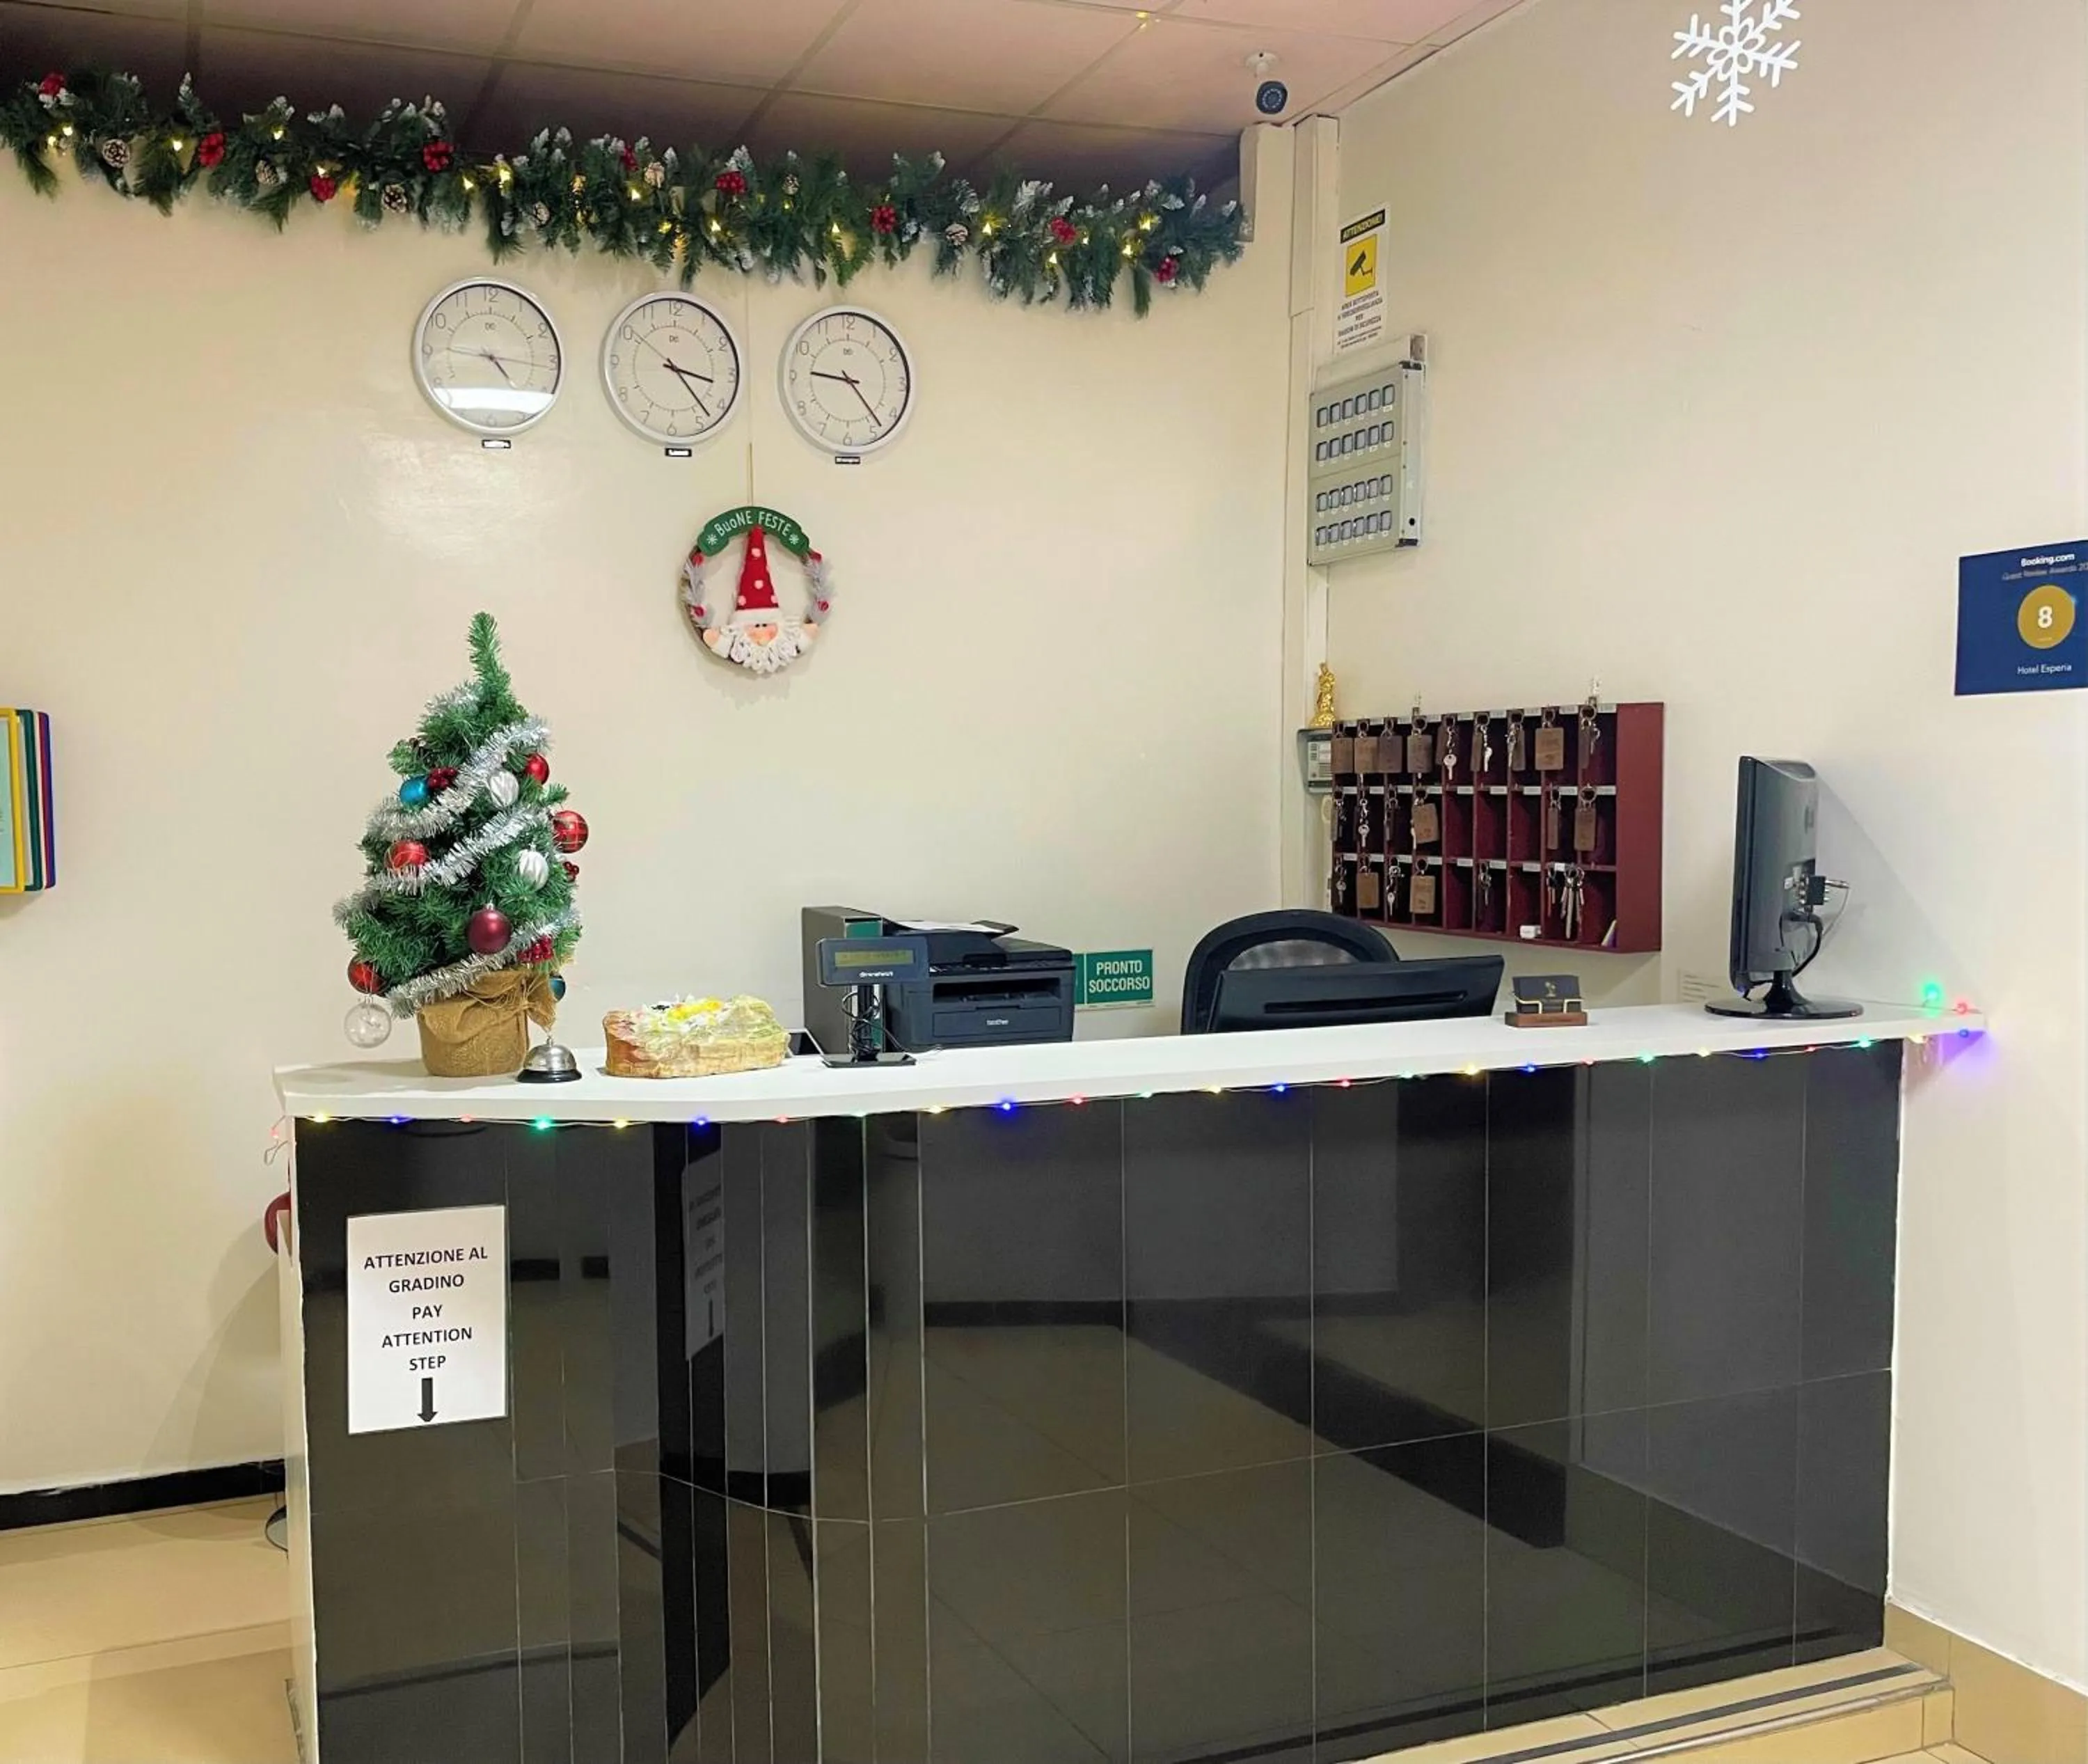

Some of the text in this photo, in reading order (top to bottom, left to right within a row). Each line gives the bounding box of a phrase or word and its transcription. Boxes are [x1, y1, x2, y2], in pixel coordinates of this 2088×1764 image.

[456, 292, 468, 307] 11
[484, 287, 498, 302] 12
[642, 305, 654, 320] 11
[668, 301, 683, 317] 12
[429, 313, 446, 329] 10
[818, 320, 828, 335] 11
[841, 315, 855, 330] 12
[538, 322, 548, 338] 2
[619, 325, 633, 340] 10
[718, 336, 727, 352] 2
[796, 341, 809, 356] 10
[548, 355, 557, 370] 3
[610, 354, 619, 369] 9
[889, 348, 898, 363] 2
[728, 367, 736, 384] 3
[789, 370, 797, 385] 9
[899, 377, 906, 392] 3
[619, 386, 628, 402] 8
[717, 399, 725, 410] 4
[798, 400, 806, 416] 8
[640, 410, 649, 425] 7
[889, 407, 897, 419] 4
[667, 423, 677, 436] 6
[696, 416, 704, 430] 5
[818, 422, 827, 436] 7
[843, 432, 853, 446] 6
[870, 425, 878, 439] 5
[758, 511, 791, 537] FESTE
[2020, 553, 2075, 567] Booking.com
[2038, 606, 2053, 628] 8
[2017, 664, 2039, 675] Hotel
[1096, 959, 1142, 975] PRONTO
[1089, 976, 1150, 993] SOCCORSO
[364, 1247, 488, 1270] ATTENZIONE AL
[389, 1274, 464, 1293] GRADINO
[413, 1305, 443, 1319] PAY
[382, 1327, 473, 1348] ATTENTION
[409, 1355, 446, 1371] STEP
